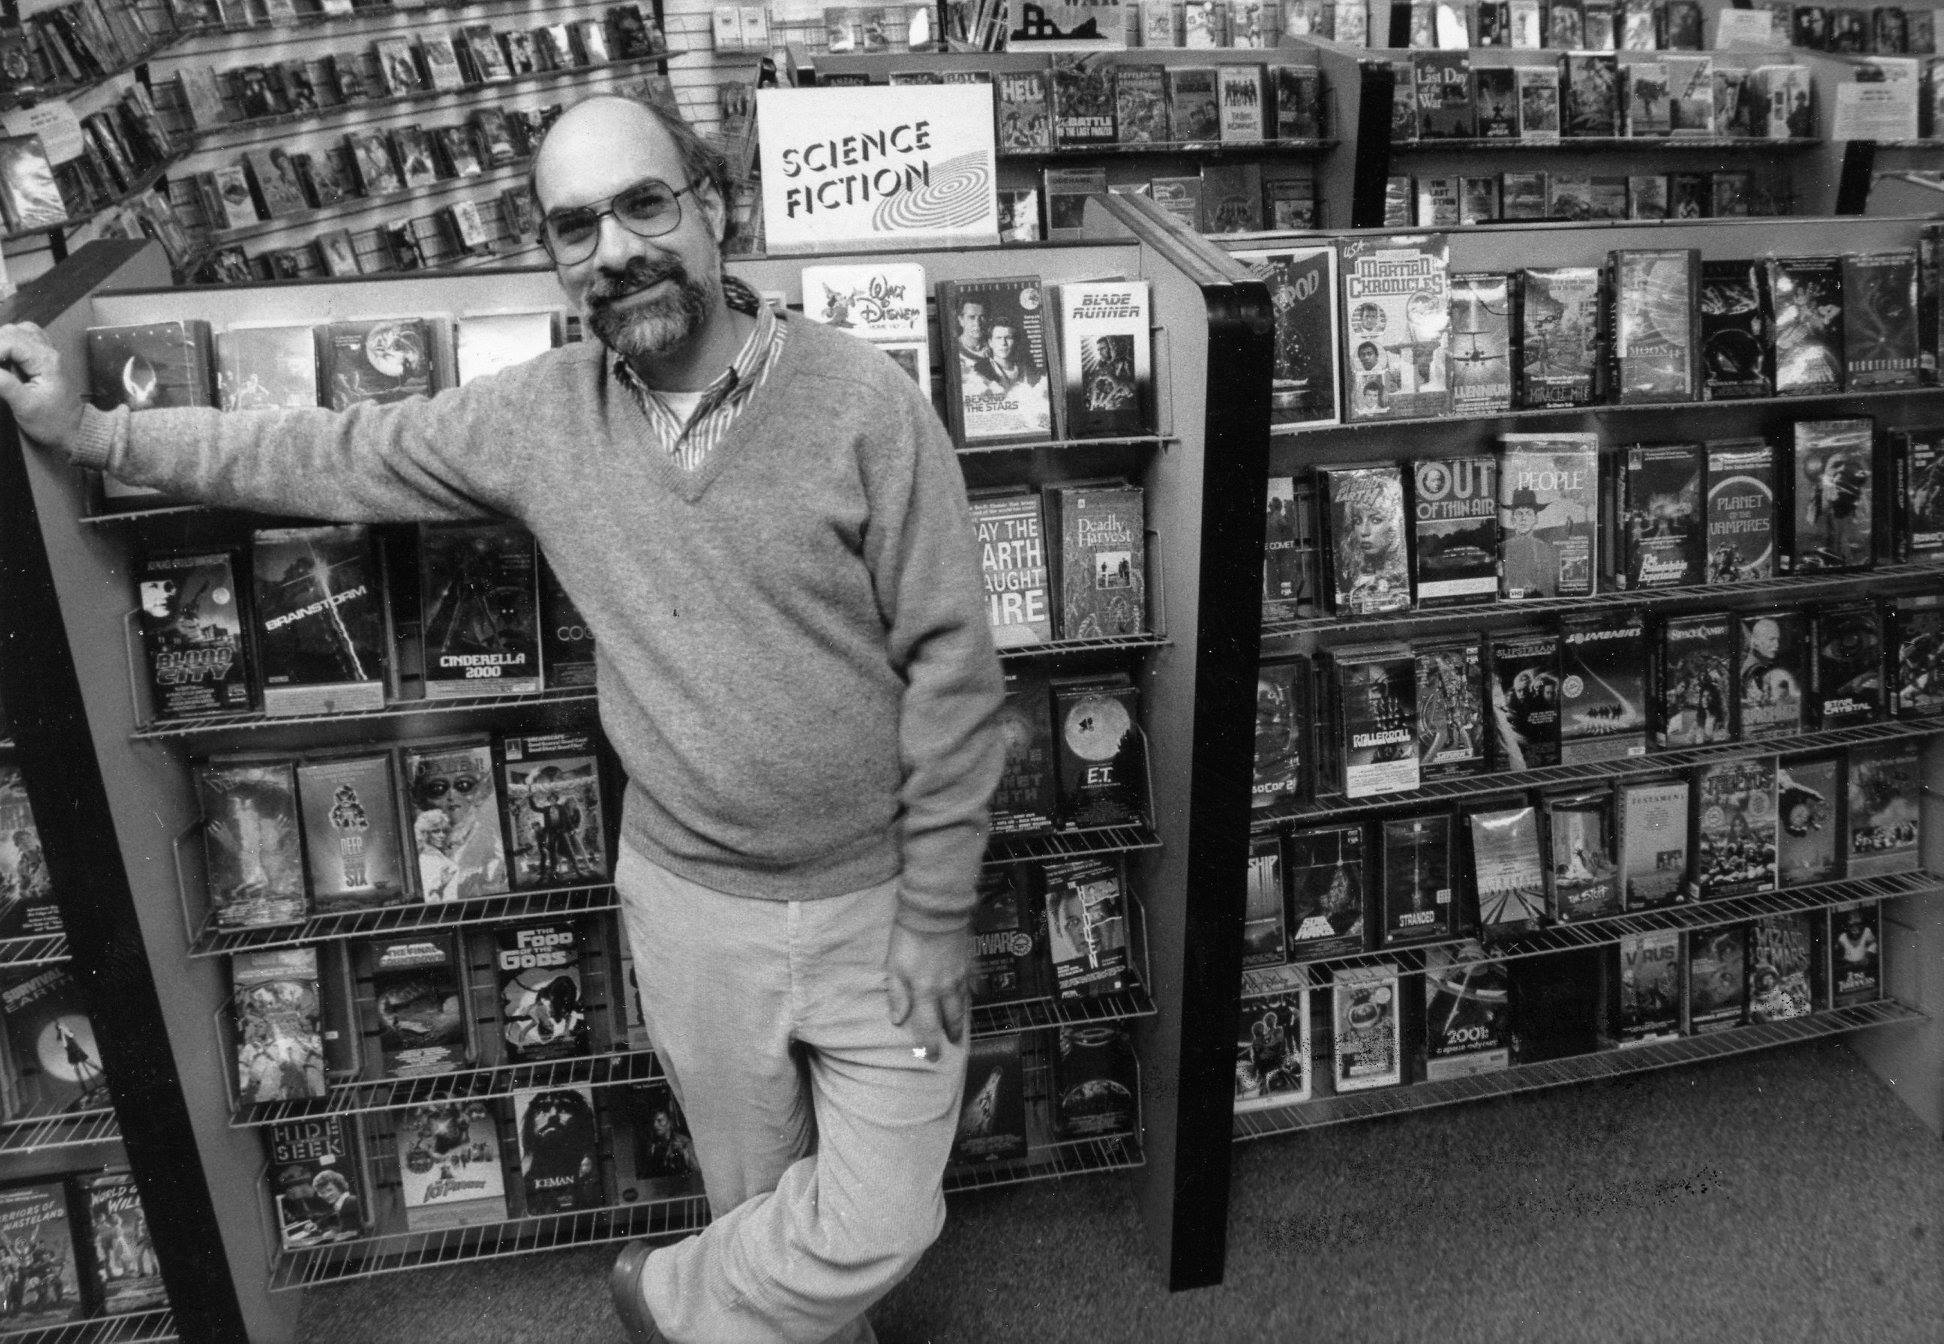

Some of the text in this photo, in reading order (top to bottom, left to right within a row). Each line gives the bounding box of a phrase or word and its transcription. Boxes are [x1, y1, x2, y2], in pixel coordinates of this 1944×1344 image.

[1417, 67, 1467, 92] Last Day
[1419, 92, 1442, 108] War
[783, 120, 931, 177] SCIENCE
[787, 160, 929, 219] FICTION
[1360, 258, 1431, 279] MARTIAN
[1349, 273, 1443, 299] CHRONICLES
[1082, 293, 1132, 306] BLADE
[1072, 306, 1141, 319] RUNNER
[966, 401, 1018, 412] THE STARS
[1416, 460, 1496, 501] OUT
[1518, 471, 1584, 491] PEOPLE
[1417, 498, 1495, 519] OF THIN AIR
[1716, 495, 1764, 511] PLANET
[974, 518, 1039, 542] AY THE
[1077, 512, 1123, 534] Deadly
[1709, 518, 1770, 535] VAMPIRES
[1078, 528, 1132, 547] Harvest
[1270, 541, 1295, 549] COMET
[982, 538, 1042, 572] ARTH
[984, 568, 1042, 593] AUGHT
[265, 585, 367, 631] BRAINSTORM
[985, 589, 1045, 626] IRE
[156, 646, 234, 669] BLOOD
[439, 653, 526, 668] CINDERELLA
[1496, 643, 1557, 658] SLIPSTREAM
[156, 662, 234, 686] CITY
[465, 666, 501, 679] 2000
[1353, 728, 1412, 748] ROLLERBALL
[1087, 767, 1114, 784] E.T.
[340, 836, 362, 856] DEEP
[345, 873, 368, 887] SIX
[1399, 911, 1435, 928] STRANDED
[517, 931, 573, 950] FOOD
[500, 950, 568, 971] GODS
[4, 974, 74, 1014] EARTH
[274, 1115, 340, 1142] HIDE
[277, 1138, 342, 1161] SEEK
[42, 1200, 55, 1212] OF
[2, 1208, 65, 1232] WASTELAND
